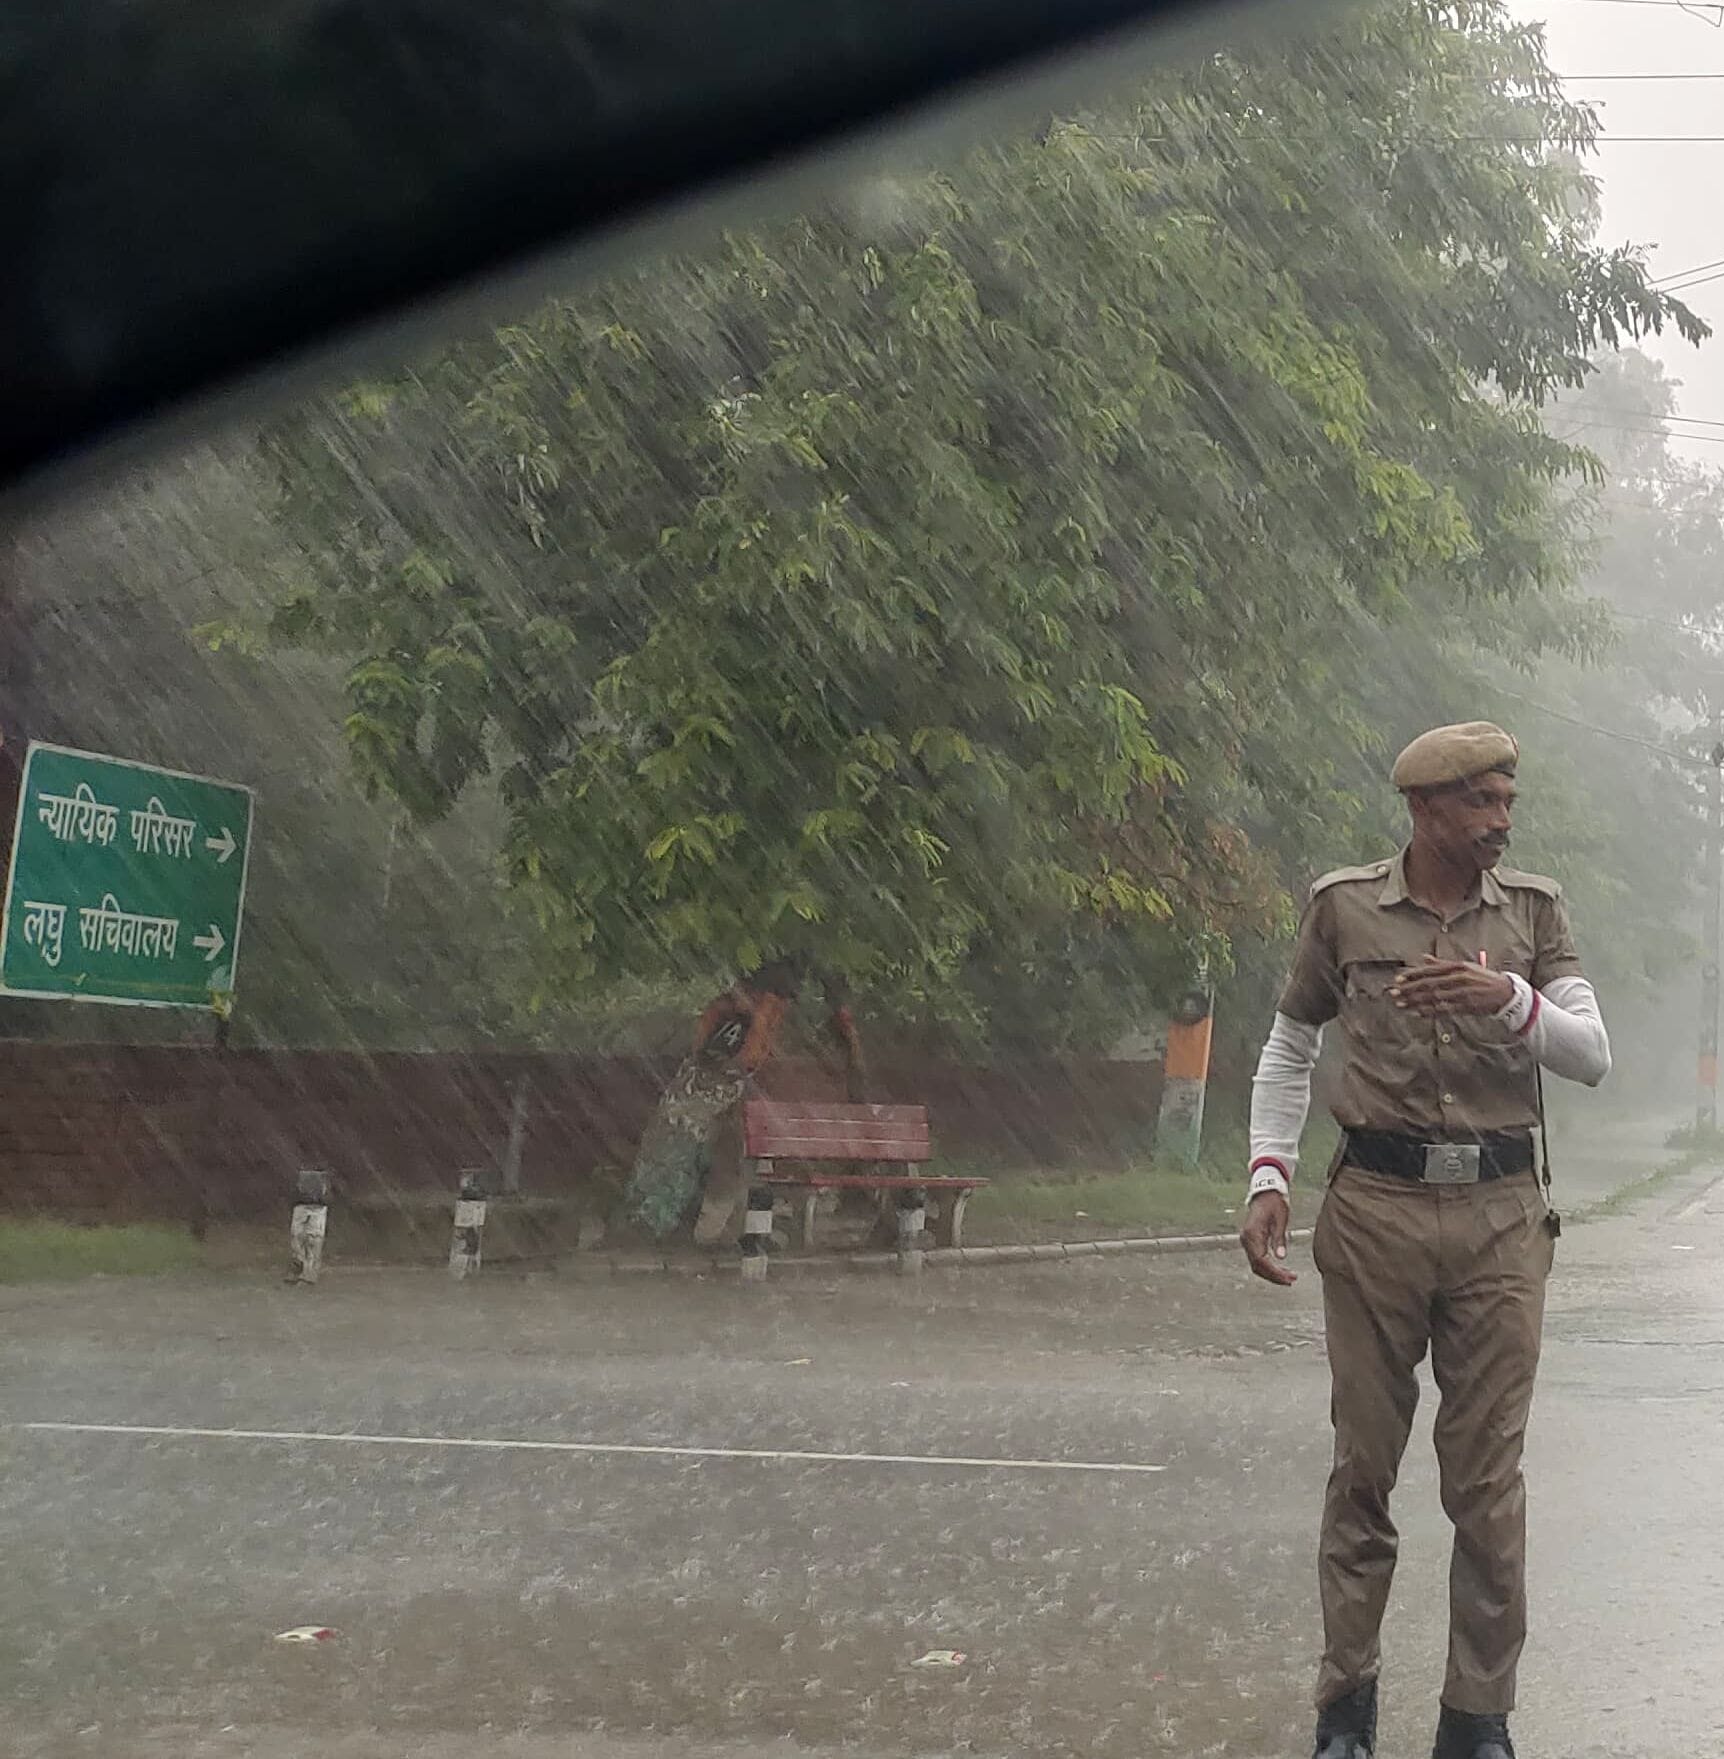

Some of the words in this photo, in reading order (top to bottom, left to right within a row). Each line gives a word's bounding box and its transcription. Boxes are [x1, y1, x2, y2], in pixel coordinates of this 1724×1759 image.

[38, 783, 120, 846] न्यायिक
[128, 796, 197, 859] परिसर
[24, 901, 67, 967] लघु
[79, 893, 179, 960] सचिवालय
